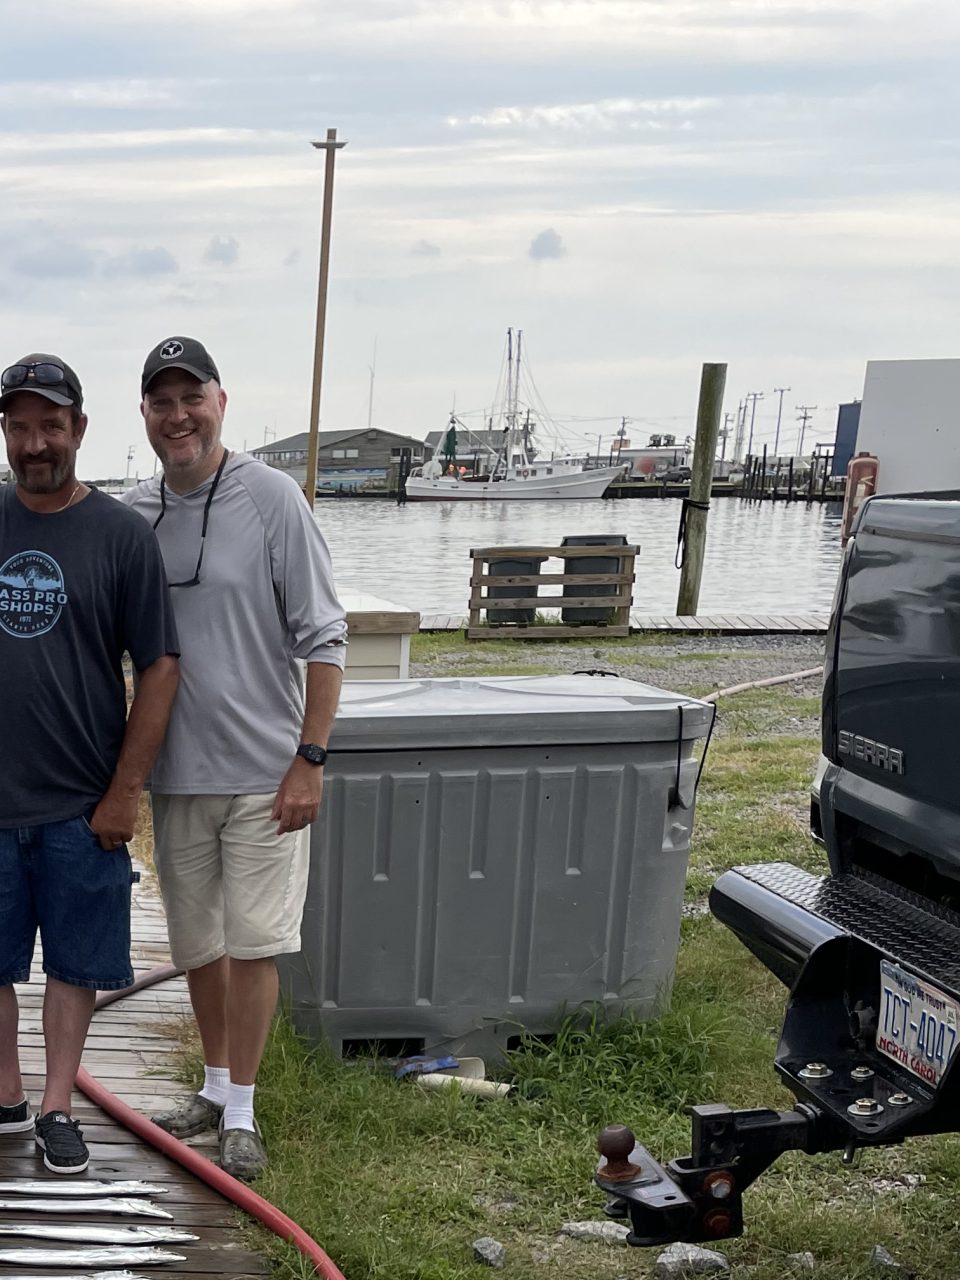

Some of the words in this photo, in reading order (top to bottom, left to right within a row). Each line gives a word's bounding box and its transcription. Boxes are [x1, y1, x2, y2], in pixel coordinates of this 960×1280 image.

[0, 600, 55, 615] SHOPS
[34, 591, 68, 605] PRO
[838, 729, 904, 776] SIERRA
[883, 986, 957, 1065] TCT-4047
[879, 1036, 909, 1064] NORTH
